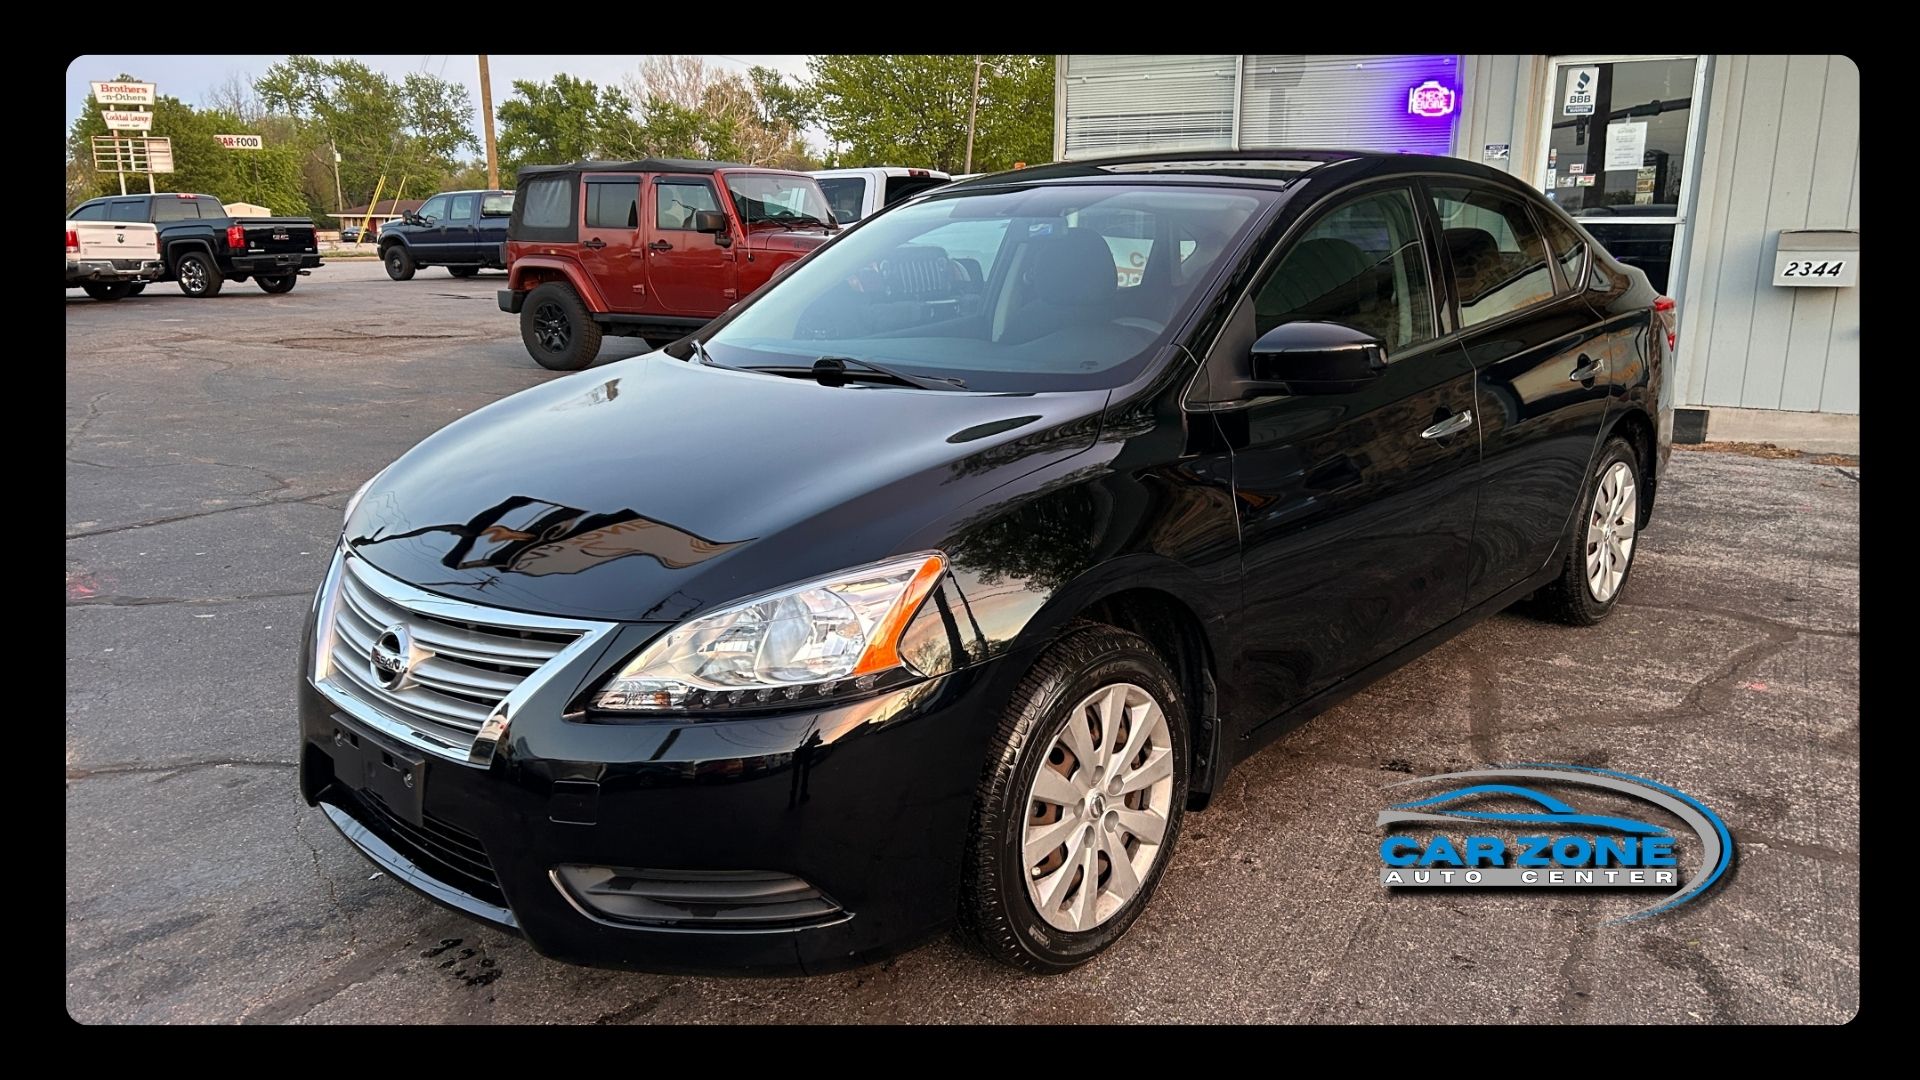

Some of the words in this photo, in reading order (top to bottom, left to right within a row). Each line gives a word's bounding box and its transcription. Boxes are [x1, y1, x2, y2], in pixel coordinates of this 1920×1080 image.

[100, 84, 148, 93] Brothers
[1415, 90, 1446, 101] CHECK
[1570, 95, 1591, 104] BBB
[105, 113, 129, 121] Cocktail
[130, 114, 150, 123] Lounge
[1784, 262, 1843, 276] 2344
